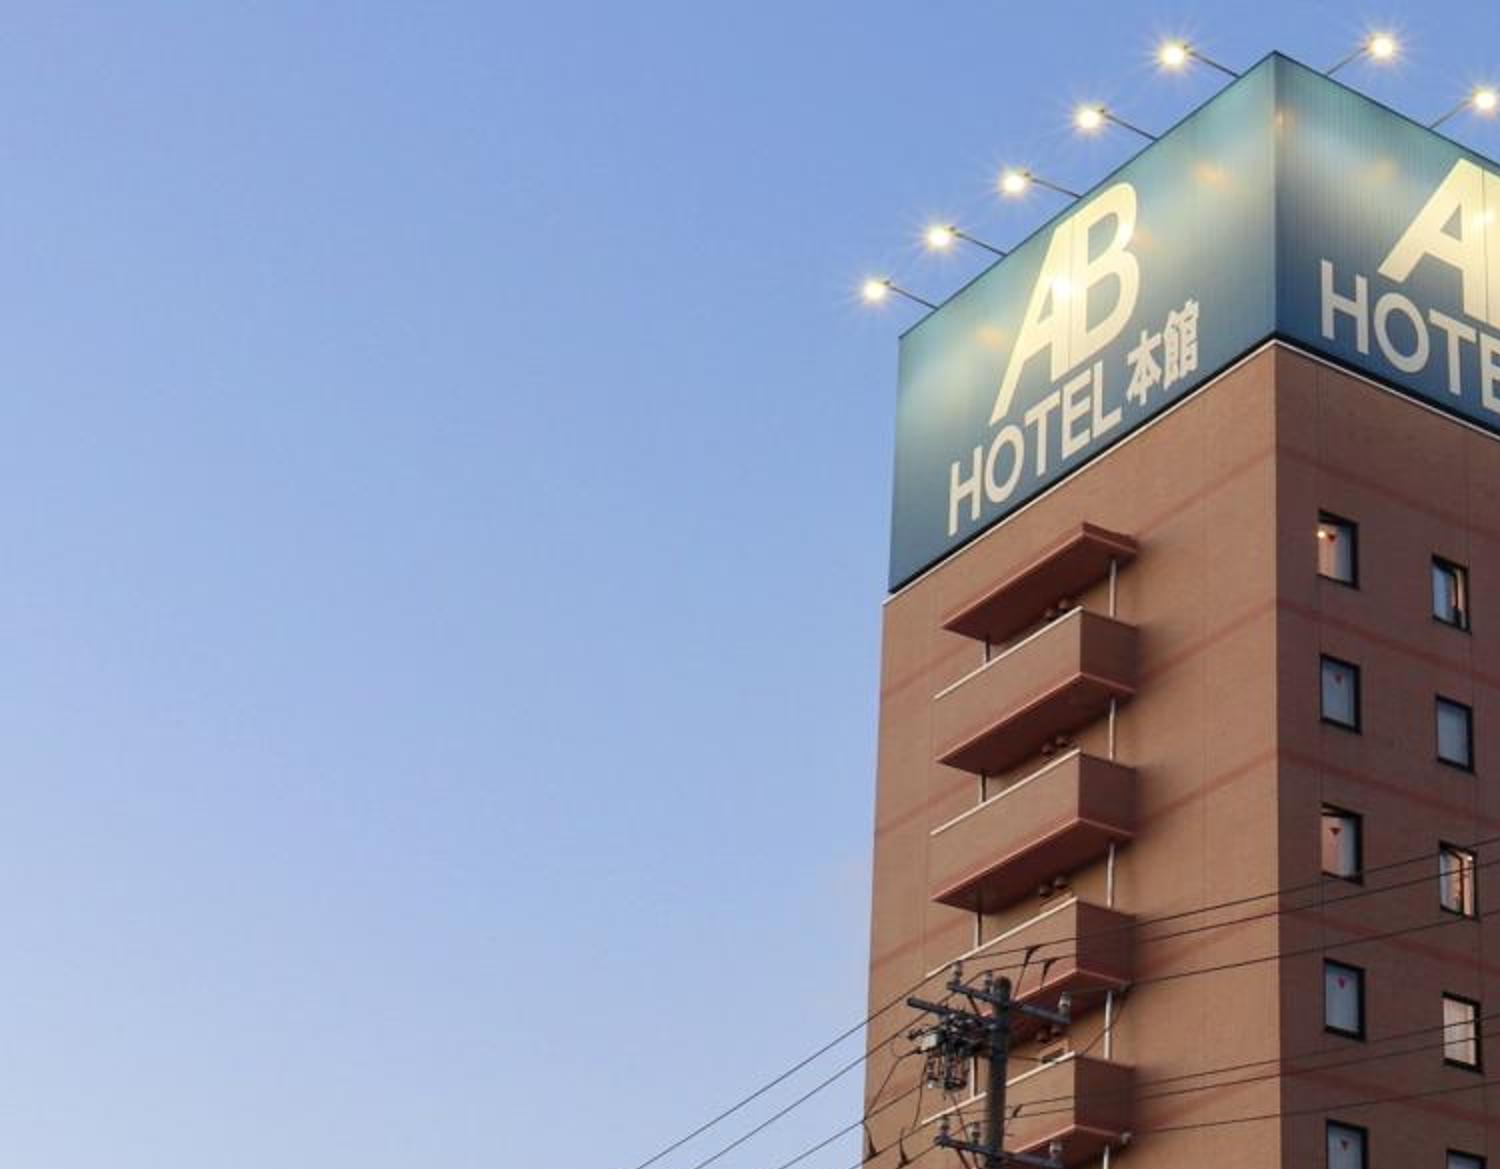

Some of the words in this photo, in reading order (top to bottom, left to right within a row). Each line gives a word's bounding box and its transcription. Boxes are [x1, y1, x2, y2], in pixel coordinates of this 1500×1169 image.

[947, 355, 1123, 536] HOTEL
[1125, 298, 1200, 405] 本館
[990, 181, 1141, 425] AB
